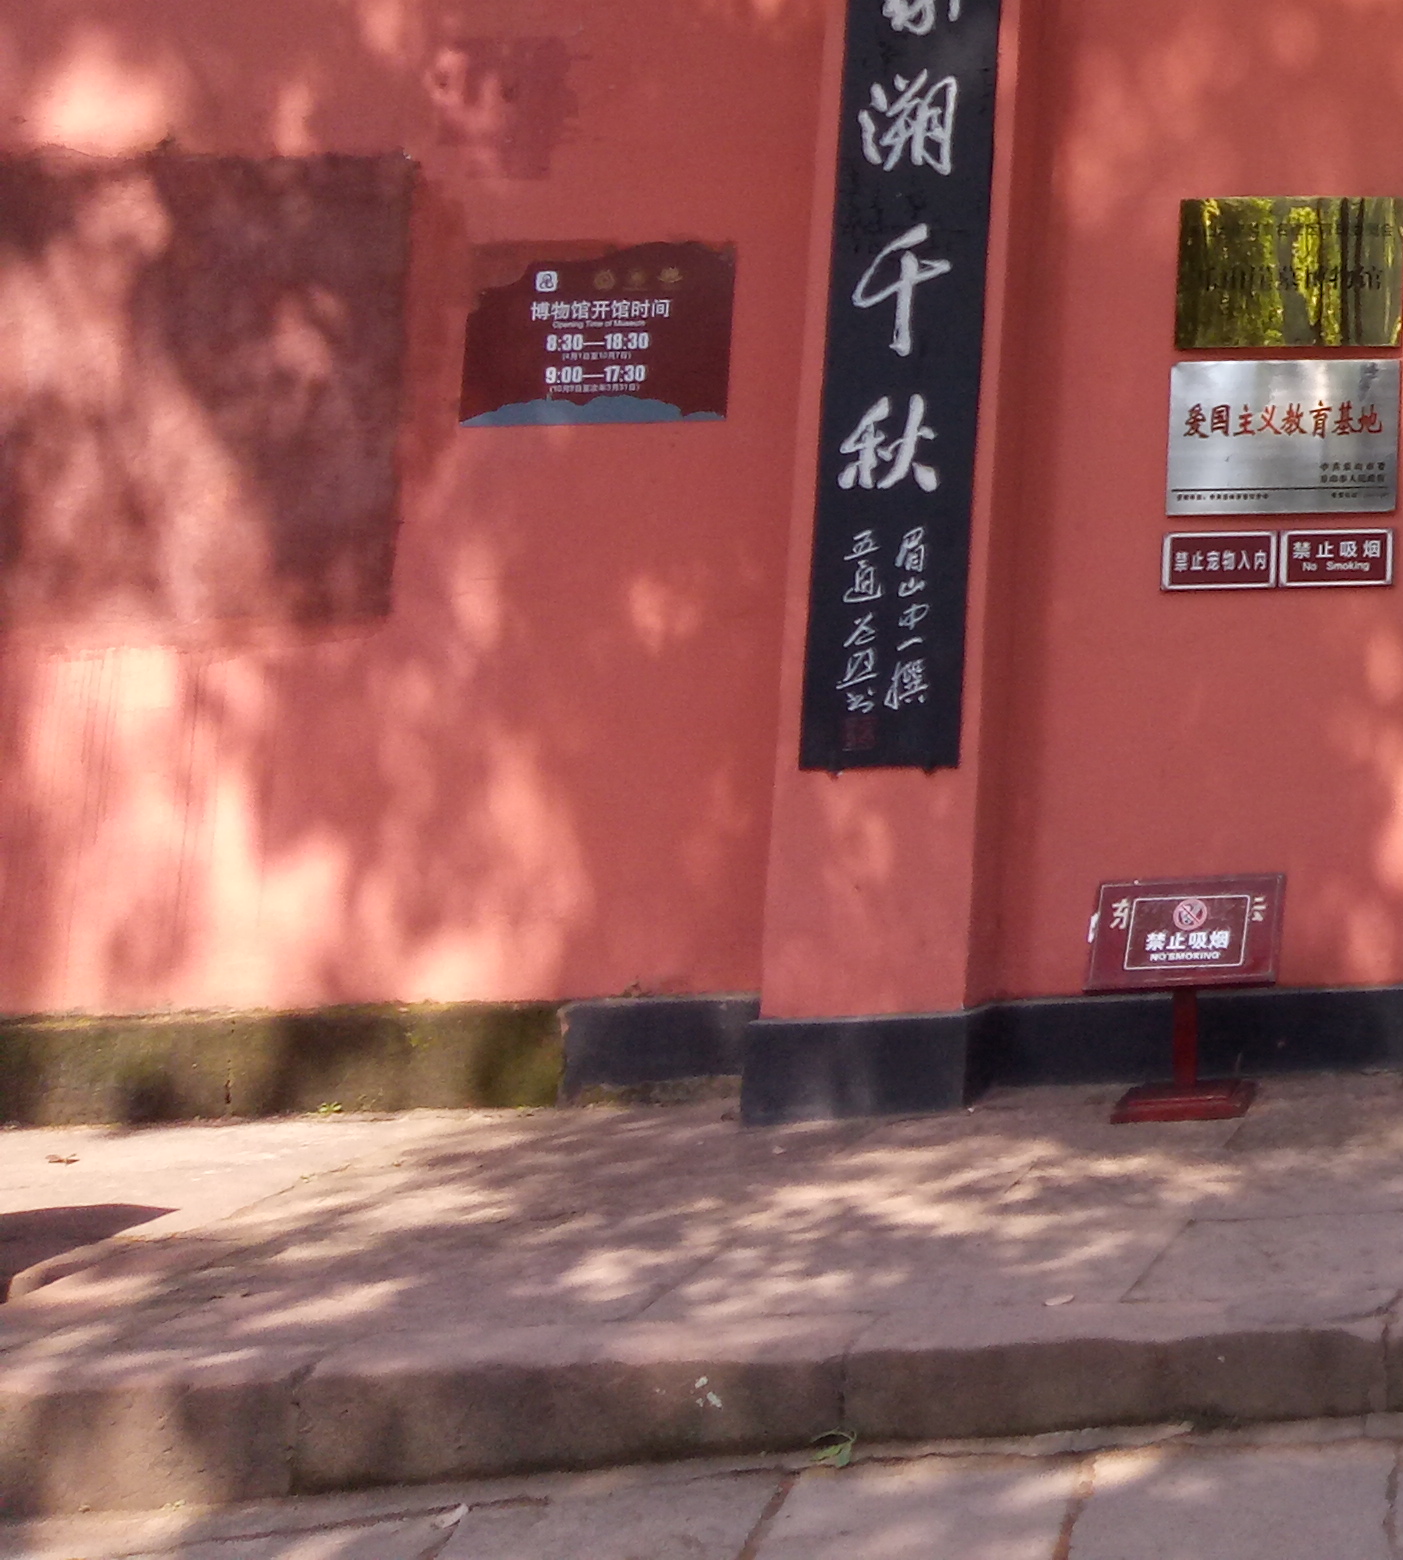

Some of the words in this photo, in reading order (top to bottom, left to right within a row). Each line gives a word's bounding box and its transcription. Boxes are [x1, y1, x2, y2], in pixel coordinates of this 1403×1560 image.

[530, 299, 671, 321] 博物馆开馆时间
[552, 321, 584, 329] Opening
[1183, 400, 1384, 439] 爱国主义教育基地
[1292, 539, 1382, 560] 禁止吸烟
[1173, 549, 1268, 573] 禁止宠物入内
[1302, 561, 1318, 572] No
[1325, 560, 1370, 573] Smoking
[1145, 930, 1230, 952] 禁止吸烟
[1150, 952, 1166, 961] NO
[1168, 951, 1221, 960] SMOKING
